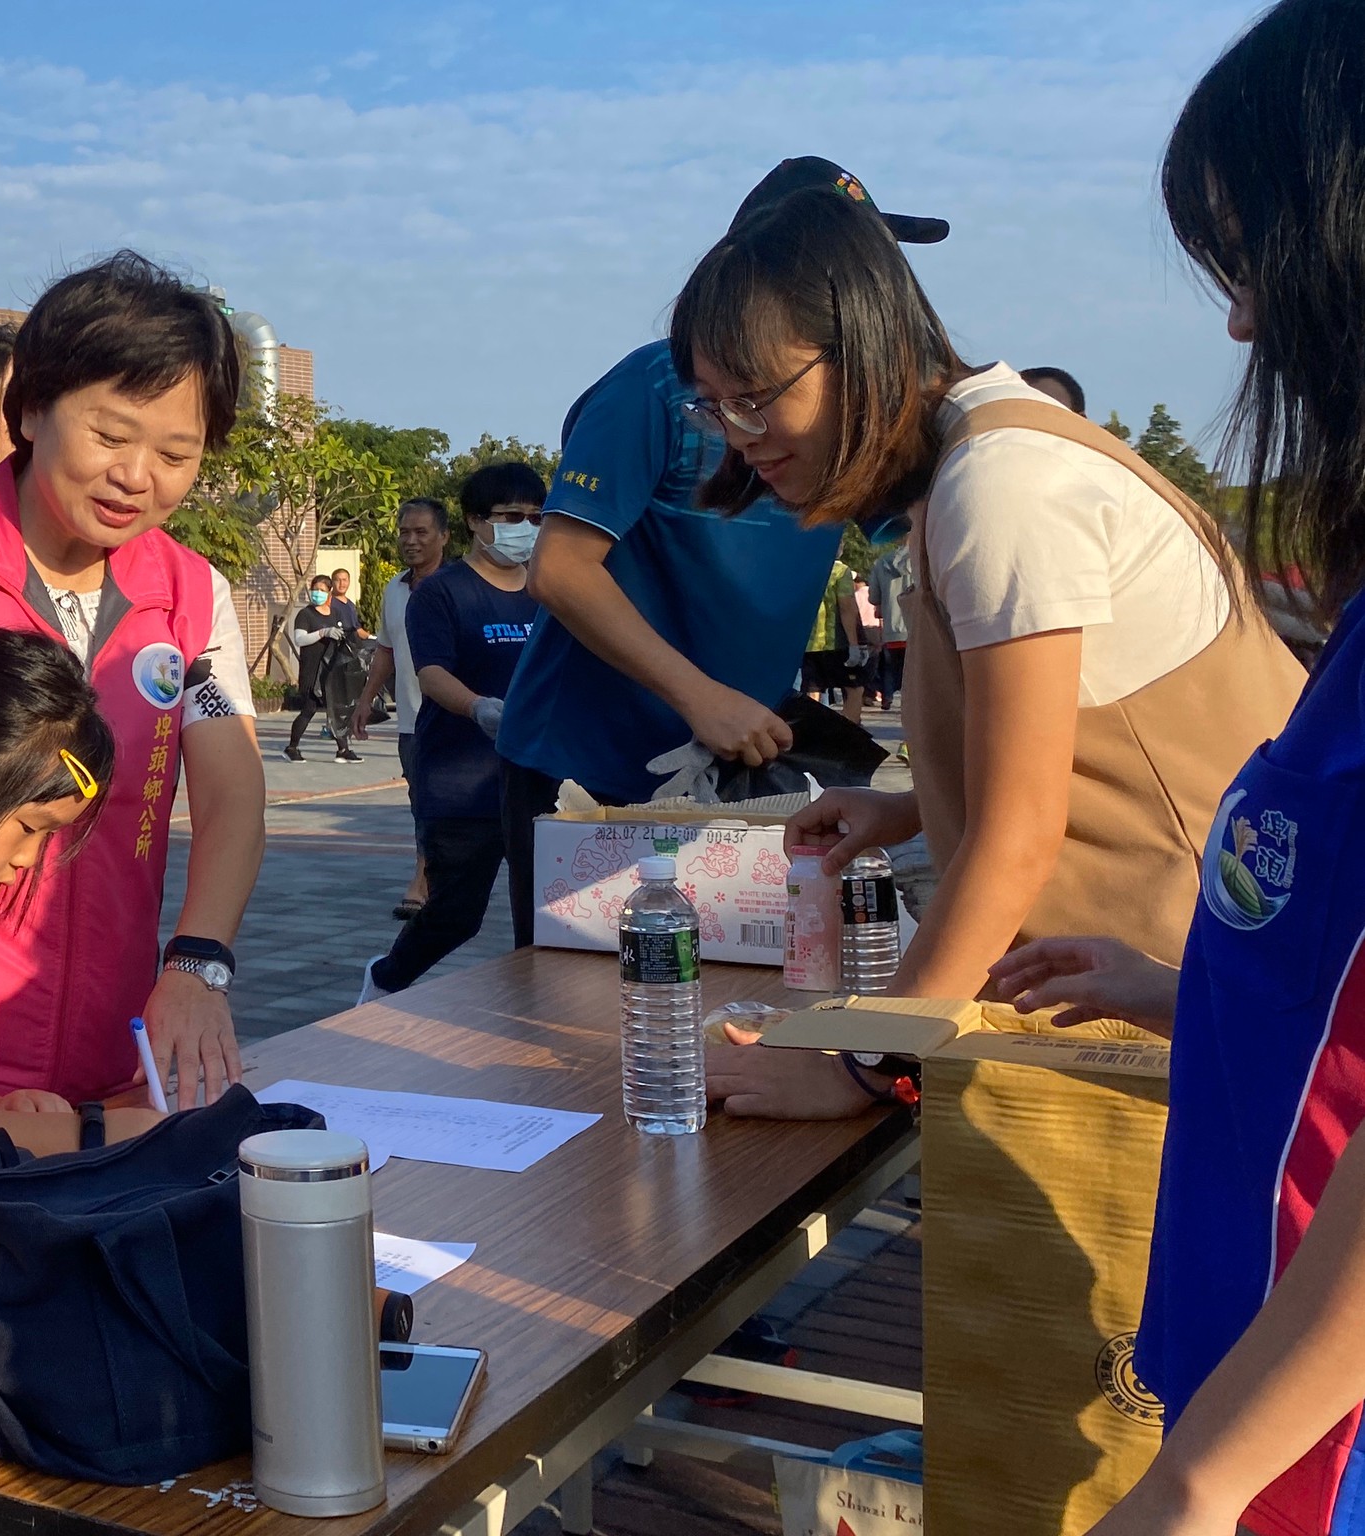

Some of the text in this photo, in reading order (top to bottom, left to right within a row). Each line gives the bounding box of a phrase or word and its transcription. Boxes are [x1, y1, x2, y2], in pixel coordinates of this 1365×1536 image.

[483, 623, 533, 638] STILL P
[134, 712, 174, 862] 埤頭鄉公所
[664, 826, 698, 842] 12:00
[706, 829, 748, 844] 00437
